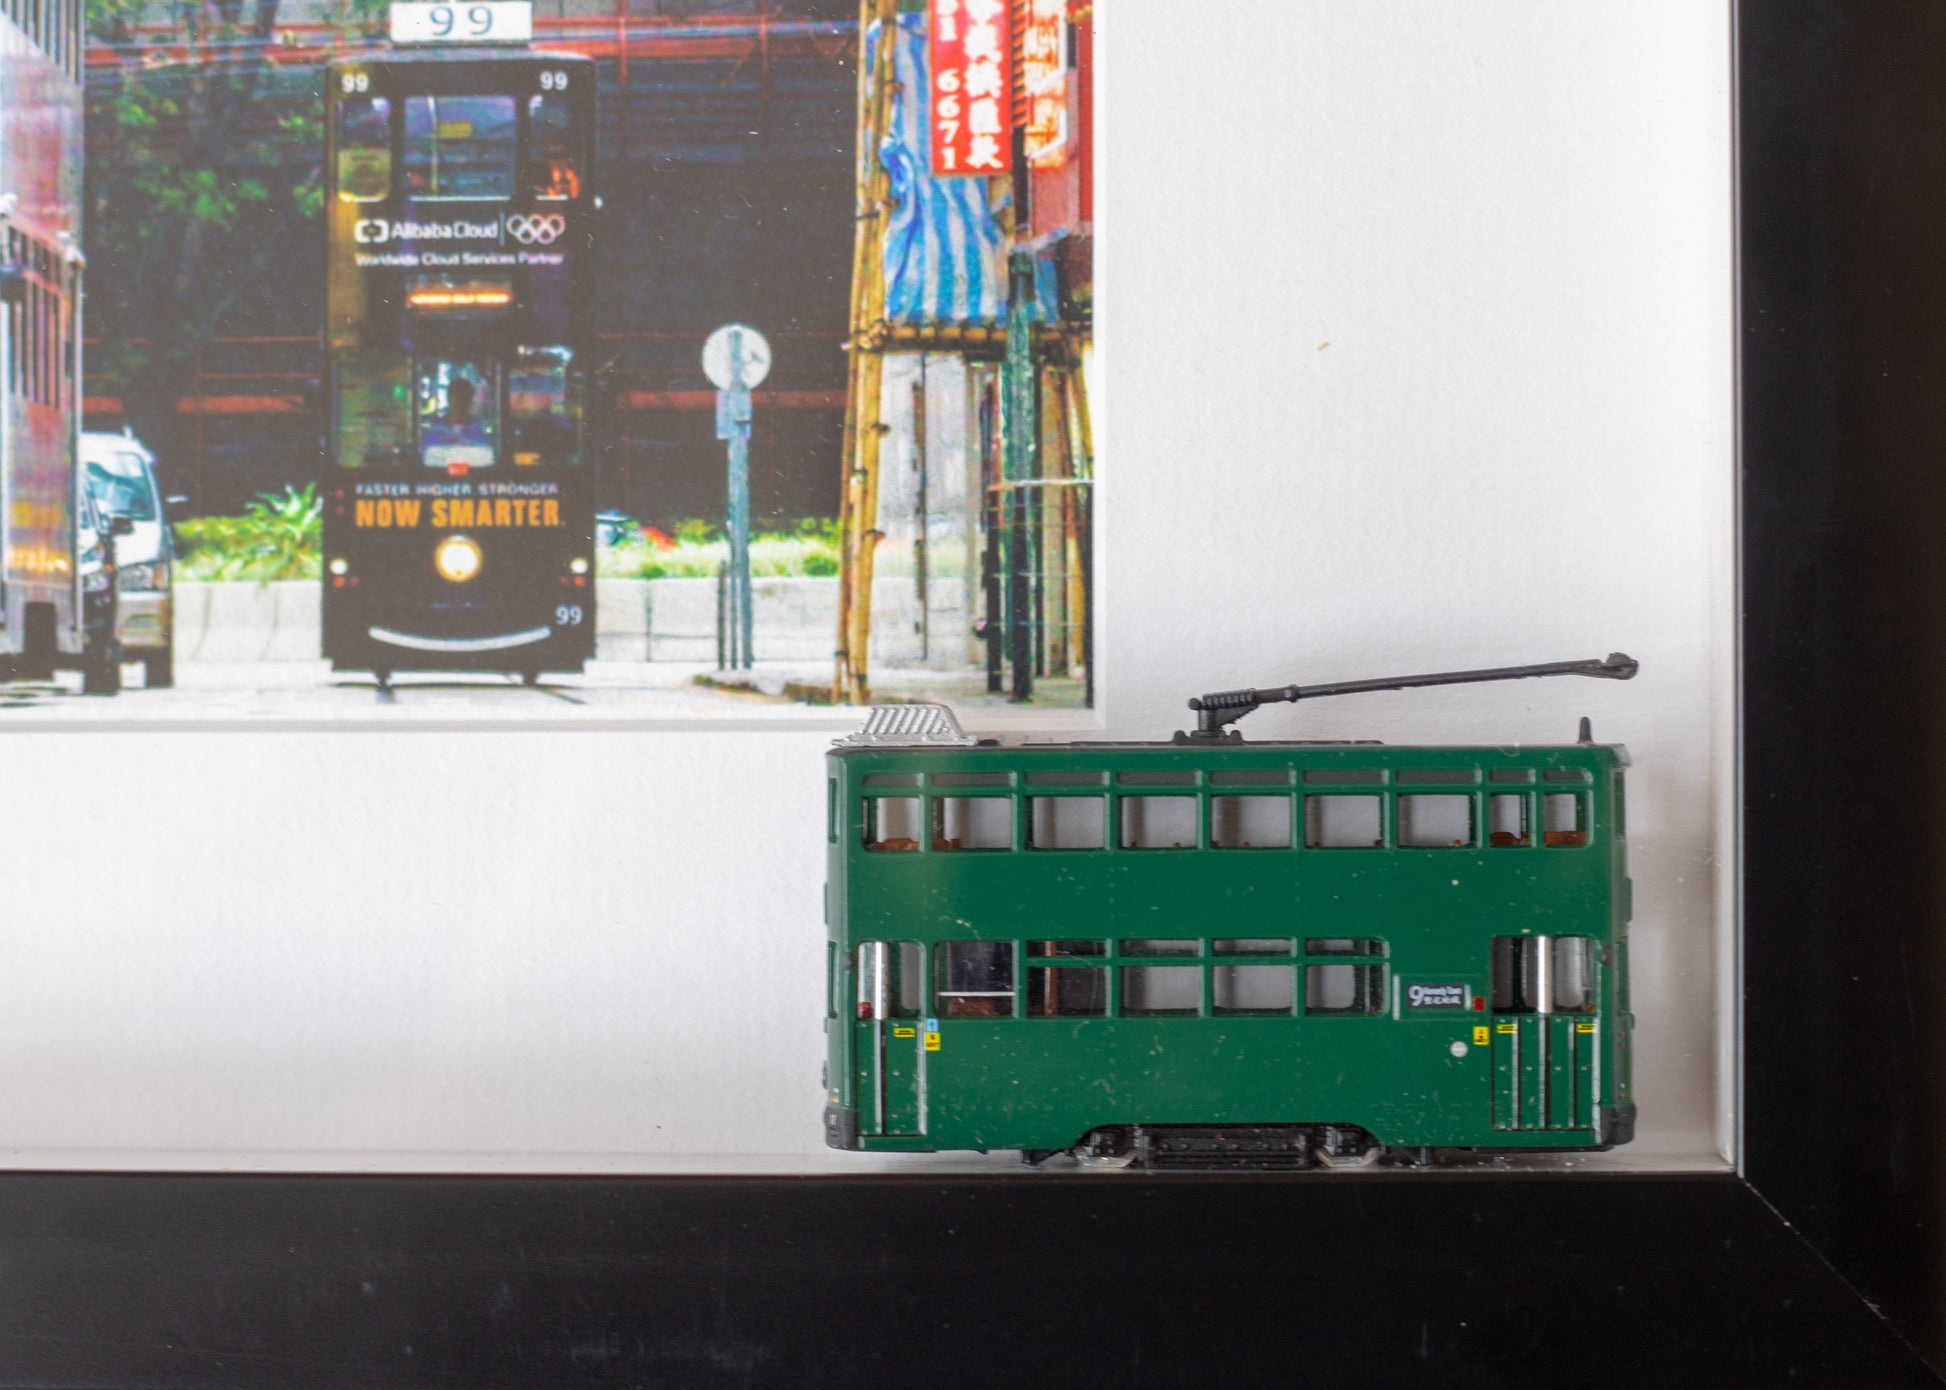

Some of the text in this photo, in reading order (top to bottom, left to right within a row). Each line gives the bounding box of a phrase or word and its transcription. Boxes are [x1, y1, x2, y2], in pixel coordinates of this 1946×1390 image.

[429, 5, 494, 36] 99
[341, 73, 370, 92] 99
[540, 71, 569, 91] 99
[936, 68, 961, 170] 6671
[390, 220, 499, 240] Alibaba Cloud
[421, 252, 460, 266] Cloud
[462, 252, 516, 266] Services
[518, 252, 564, 266] Partner
[355, 482, 559, 496] FASTER HIGHER STRONGER
[355, 498, 422, 528] NOW
[555, 604, 584, 626] 99
[1408, 985, 1424, 1007] 9
